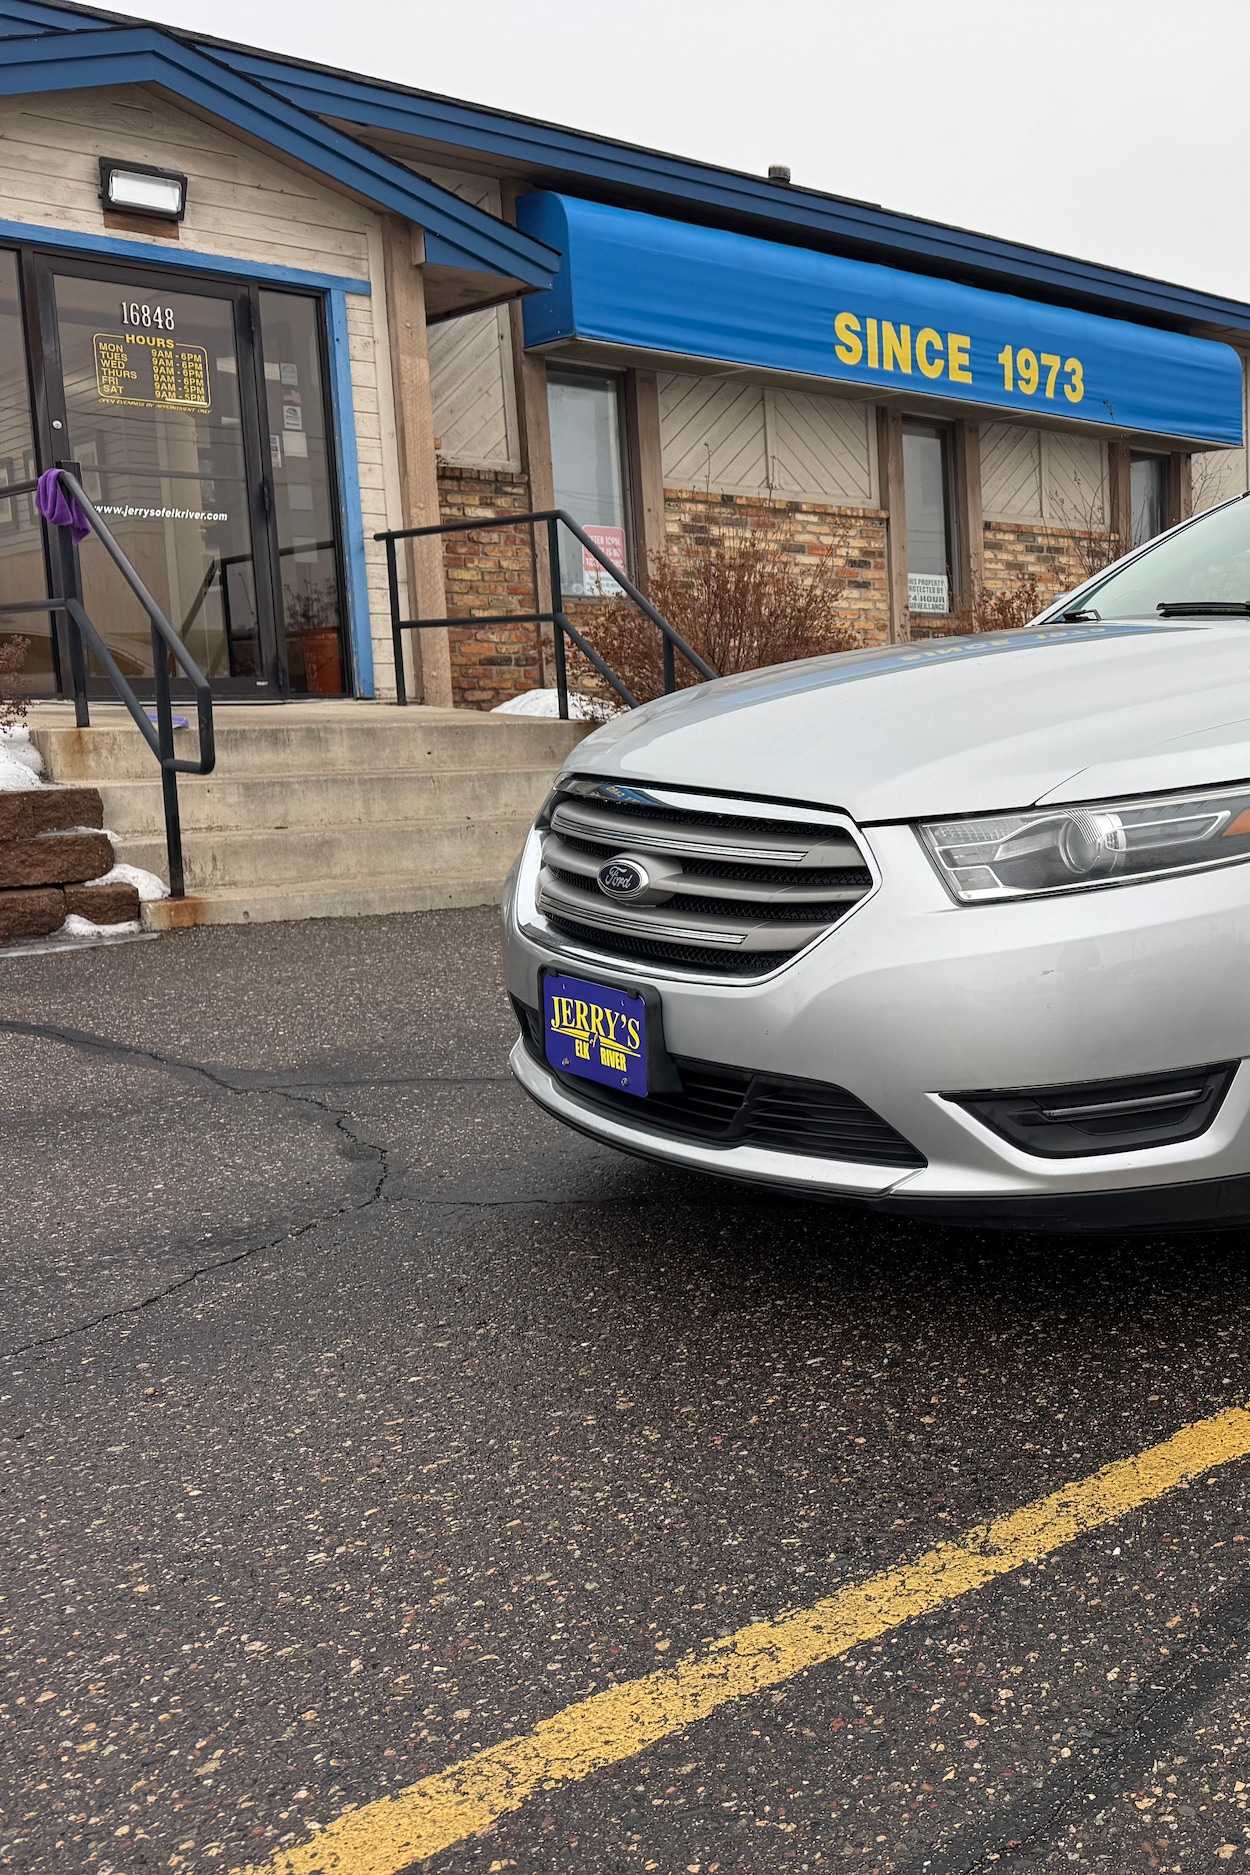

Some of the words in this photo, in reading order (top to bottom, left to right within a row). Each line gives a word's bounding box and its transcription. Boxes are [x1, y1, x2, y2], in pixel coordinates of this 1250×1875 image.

[122, 301, 175, 330] 16848
[125, 333, 175, 349] HOURS
[99, 342, 124, 352] MON
[151, 349, 173, 359] 9AM
[181, 353, 202, 363] 6PM
[100, 351, 128, 362] TUES
[152, 358, 174, 367] 9AM
[182, 362, 203, 371] 6PM
[834, 312, 973, 385] SINCE
[998, 344, 1085, 403] 1973
[100, 359, 125, 370] WED
[153, 366, 175, 375] 9AM
[182, 369, 203, 379] 6PM
[101, 368, 137, 379] THURS
[154, 374, 175, 384] 9AM
[183, 378, 204, 387] 6PM
[102, 376, 119, 385] FRI
[154, 382, 176, 391] 9AM
[184, 386, 205, 395] 5PM
[103, 384, 124, 394] SAT
[155, 390, 176, 399] 9AM
[155, 404, 196, 412] APPOINTMENT
[94, 505, 228, 521] www.jerrysofelkriver.com
[589, 535, 604, 544] FTER
[918, 578, 944, 586] PROPERTY
[605, 865, 633, 890] Ford
[551, 996, 641, 1050] JERRY'S
[575, 1038, 591, 1061] ELK
[600, 1047, 628, 1073] RIVER
